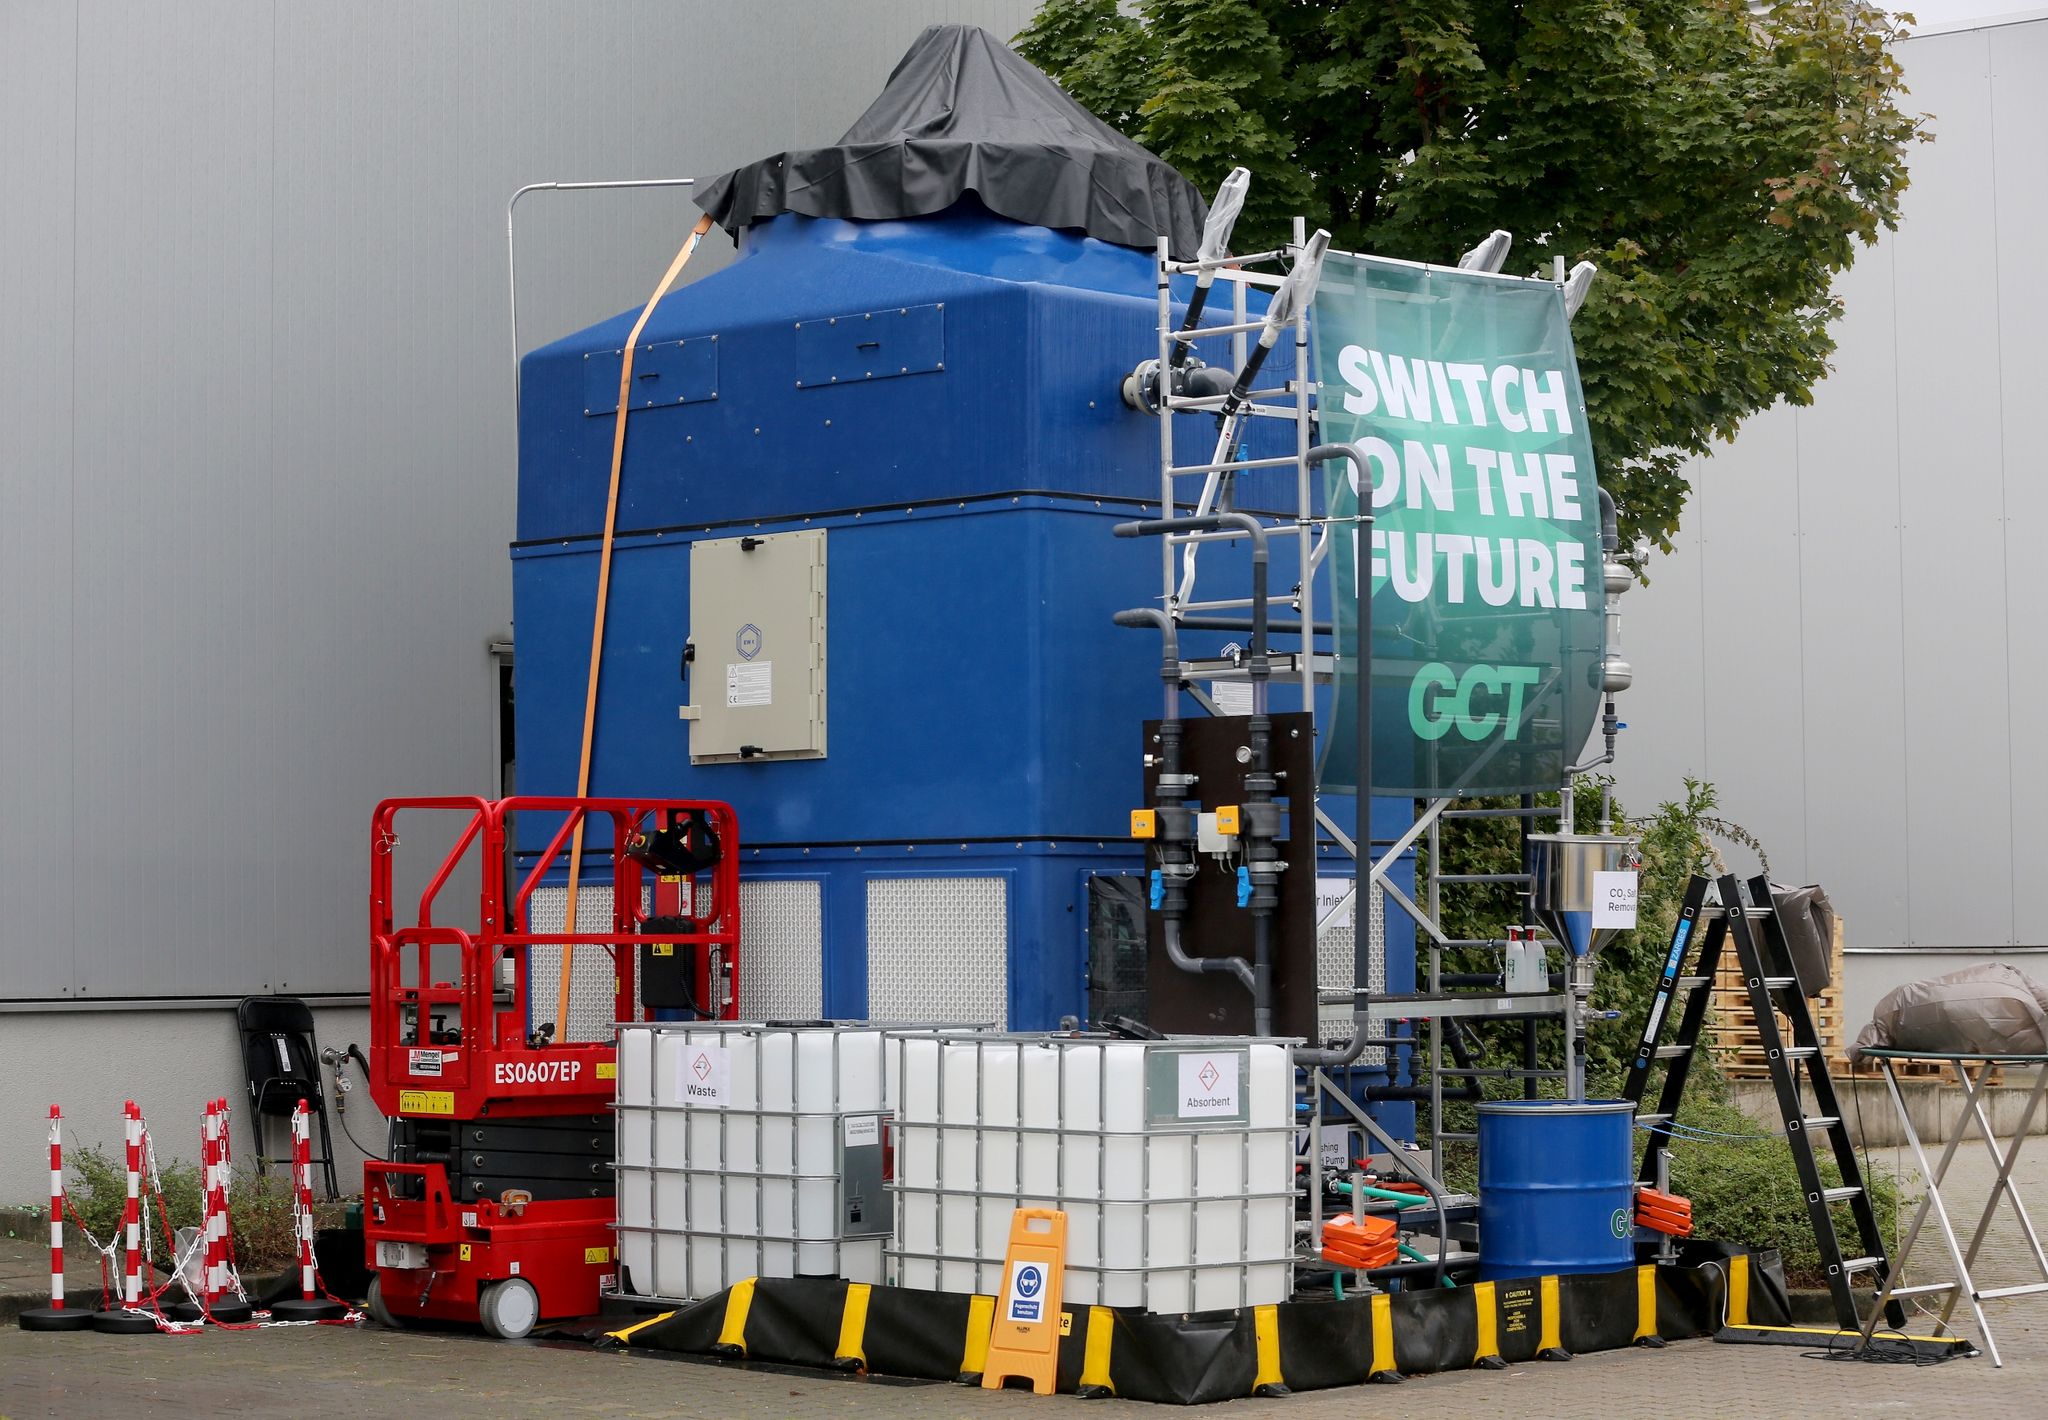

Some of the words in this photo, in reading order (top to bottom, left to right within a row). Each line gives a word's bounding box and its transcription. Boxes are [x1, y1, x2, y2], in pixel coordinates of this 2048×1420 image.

[1338, 344, 1573, 434] SWITCH
[1347, 436, 1454, 512] ON
[1467, 446, 1582, 521] THE
[1352, 528, 1587, 610] FUTURE
[1408, 662, 1539, 741] GCT
[1608, 901, 1636, 912] Remova
[1671, 928, 1687, 960] ZARGES
[495, 1061, 581, 1084] ES0607EP
[687, 1084, 717, 1098] Waste
[1187, 1097, 1230, 1108] Absorbent
[1325, 1156, 1345, 1166] Pump
[1509, 1290, 1527, 1298] CAUTION
